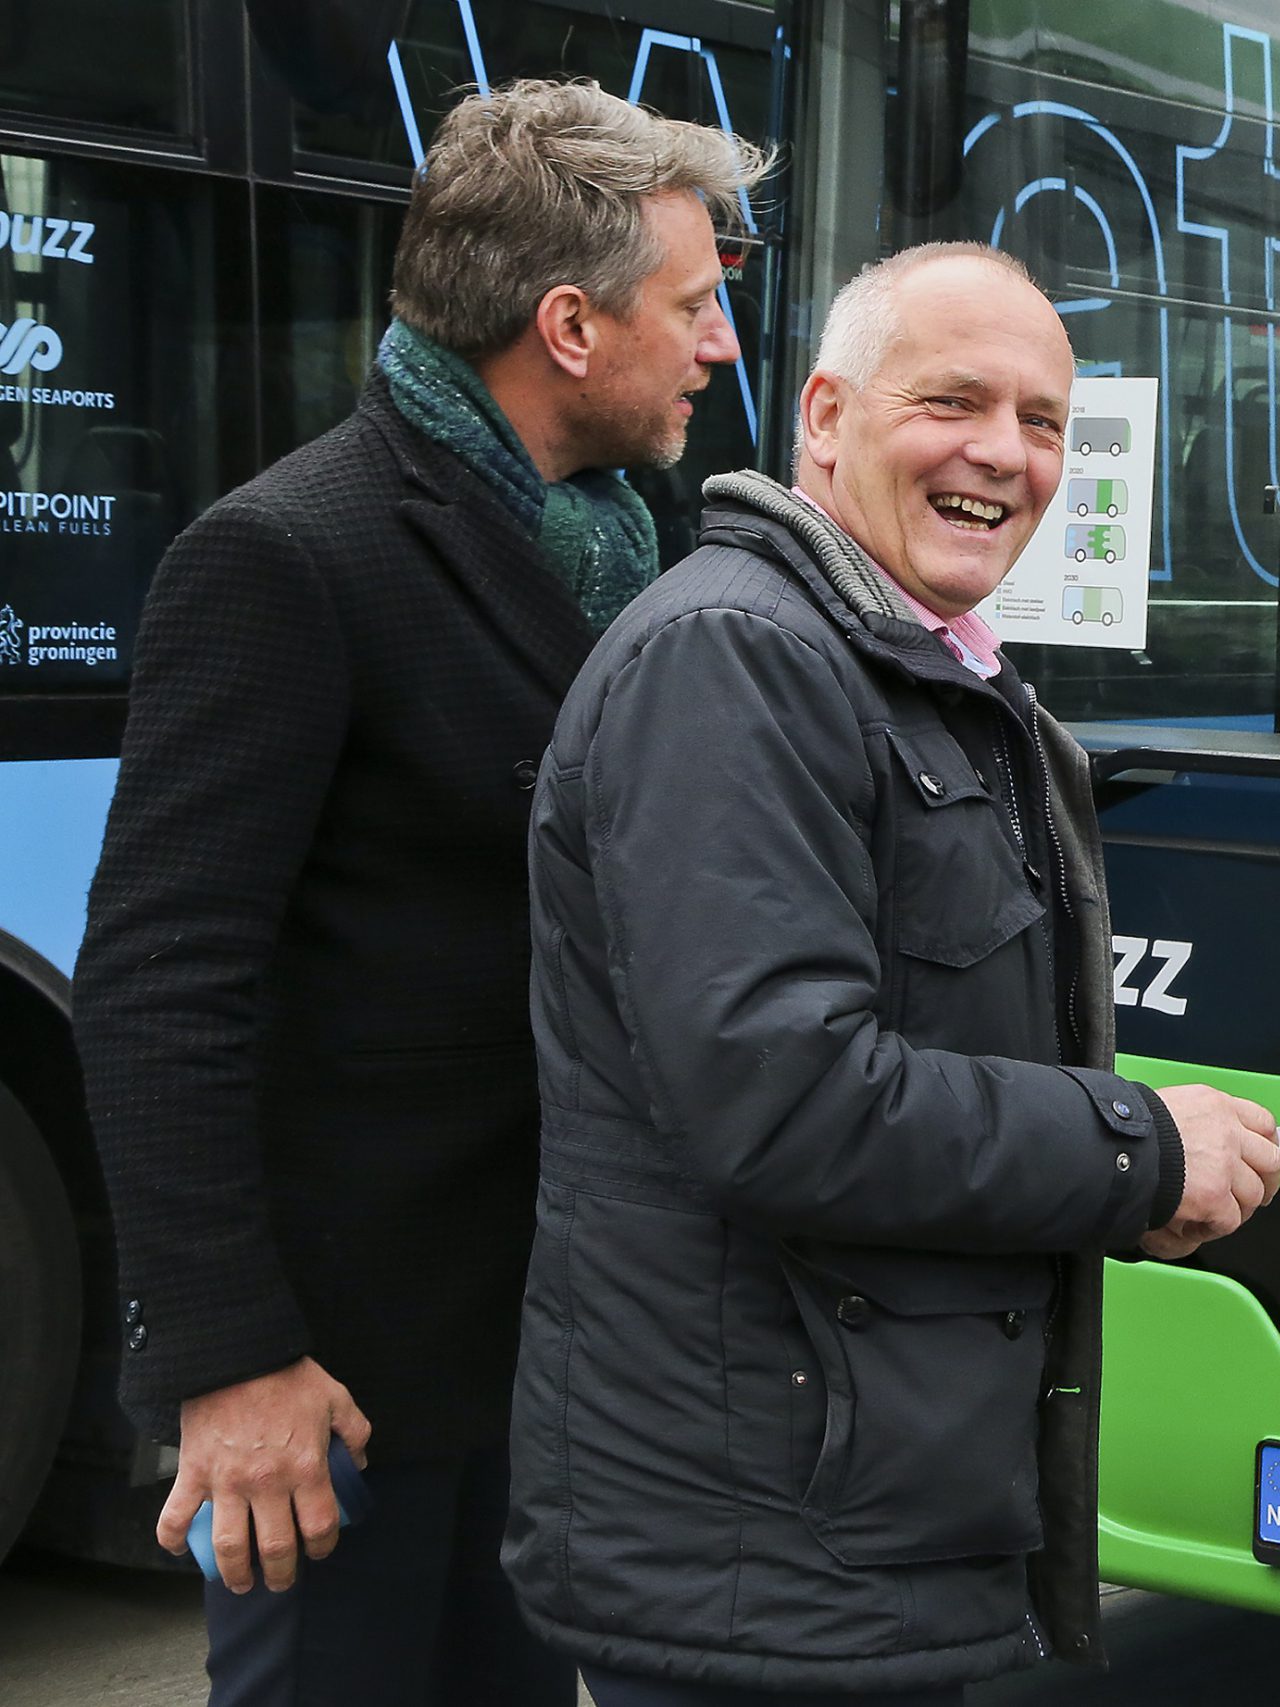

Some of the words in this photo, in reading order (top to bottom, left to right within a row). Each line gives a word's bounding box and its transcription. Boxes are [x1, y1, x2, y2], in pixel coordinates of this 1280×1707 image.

[32, 388, 115, 409] SEAPORTS
[0, 519, 49, 533] LEAN
[58, 522, 112, 536] FUELS
[28, 621, 117, 645] provincie
[28, 642, 117, 666] groningen
